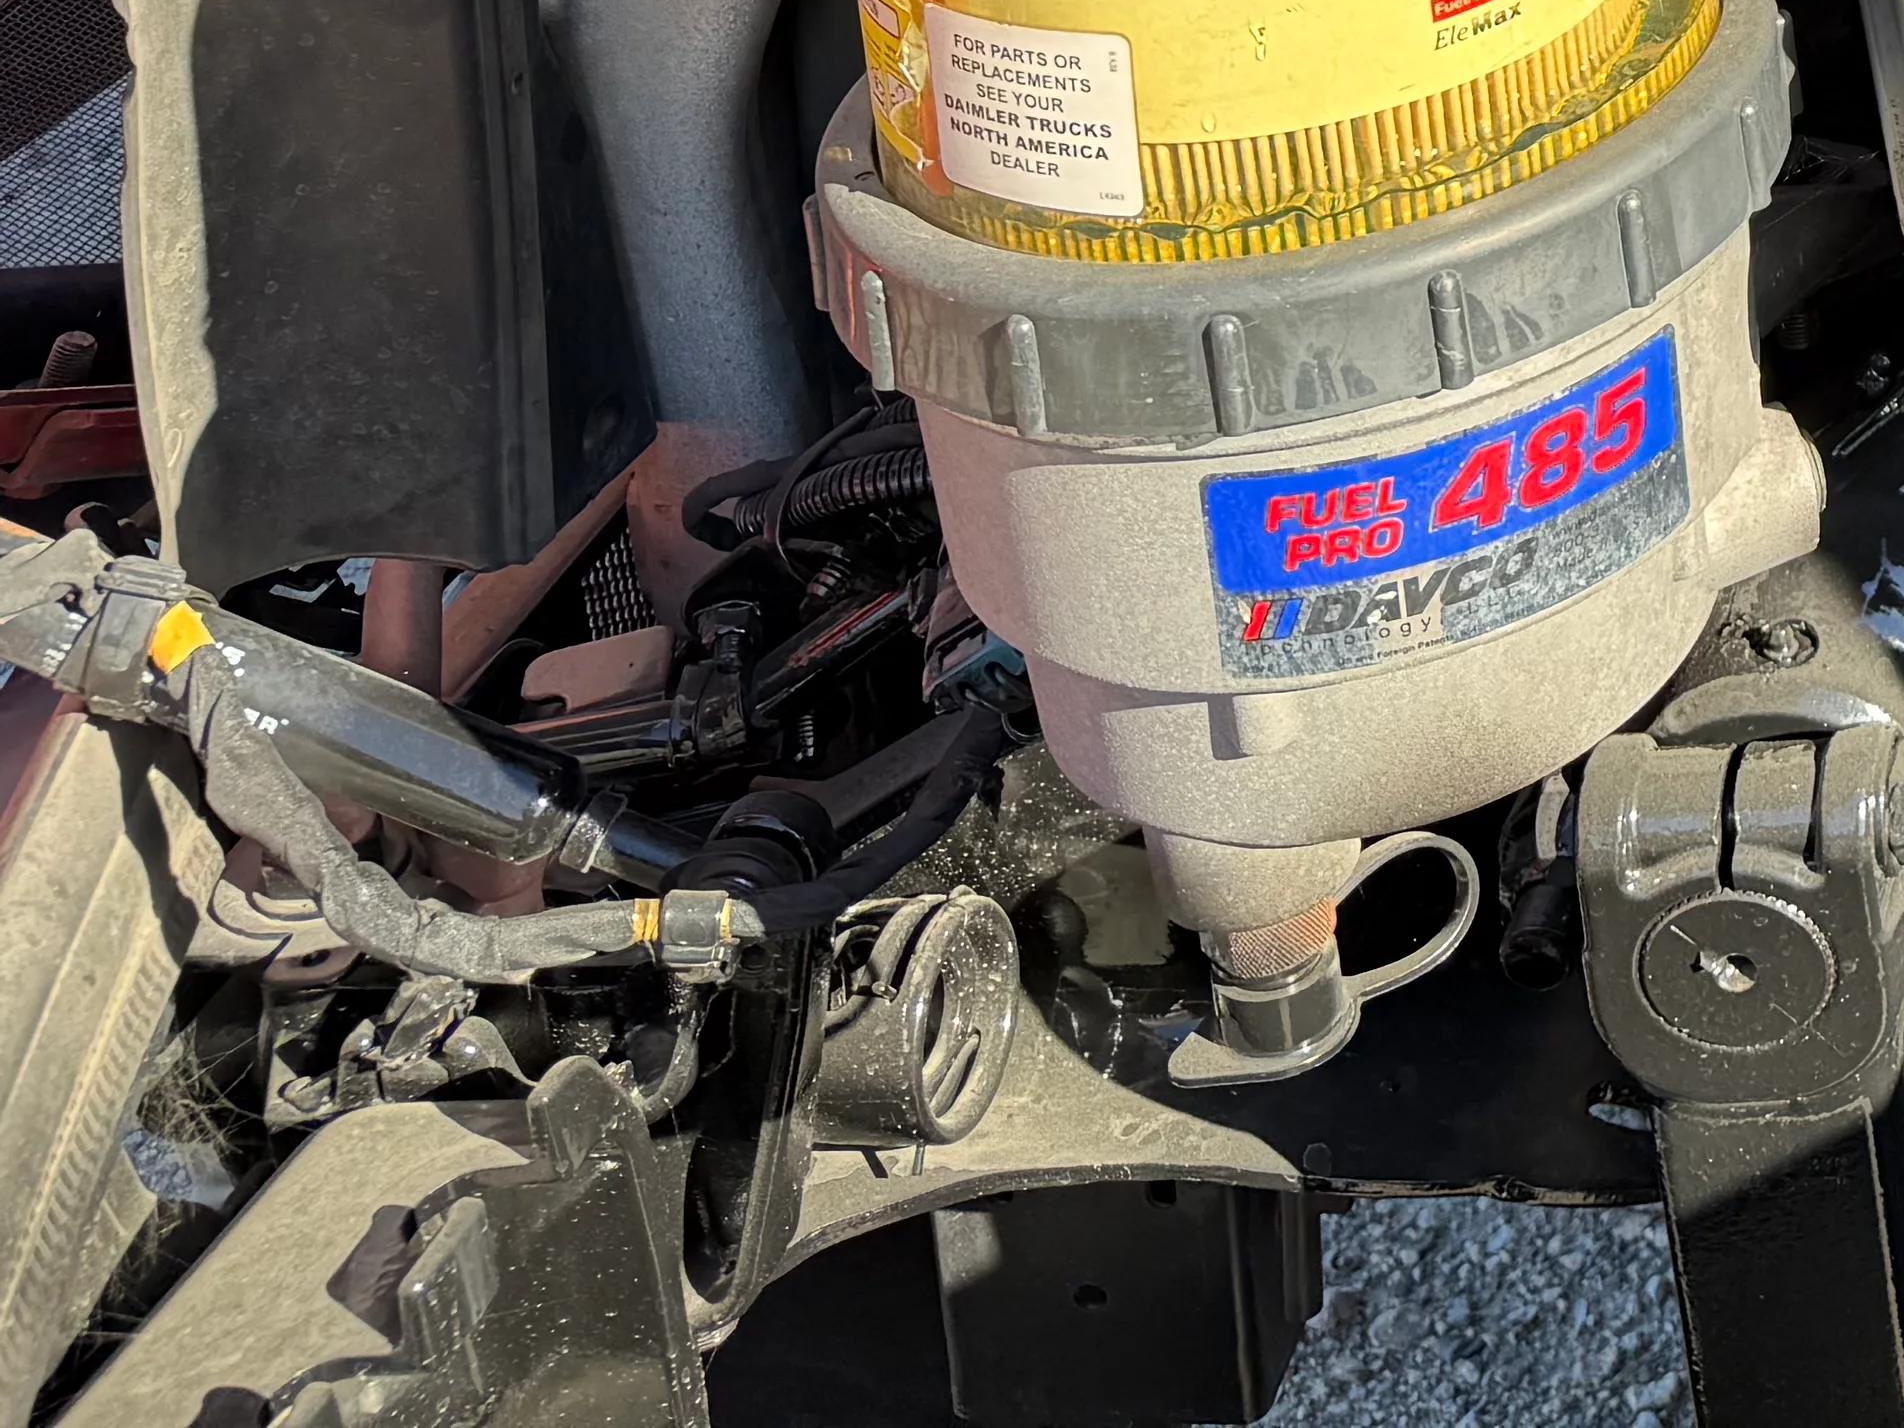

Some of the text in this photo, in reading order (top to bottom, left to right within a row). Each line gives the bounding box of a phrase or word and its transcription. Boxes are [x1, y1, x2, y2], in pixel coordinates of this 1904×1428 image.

[951, 54, 1093, 94] REPLACEMENTS
[953, 33, 1083, 71] FOR PARTS OR
[944, 93, 1114, 140] DAIMLER TRUCKS
[976, 83, 1065, 114] SEE YOUR
[950, 116, 1110, 162] NORTH AMERICA
[990, 150, 1062, 178] DEALER
[1428, 365, 1649, 537] 485
[1264, 475, 1408, 535] FUEL
[1283, 516, 1405, 574] PRO
[1305, 536, 1539, 635] DAVCO
[1376, 643, 1416, 659] Foreign
